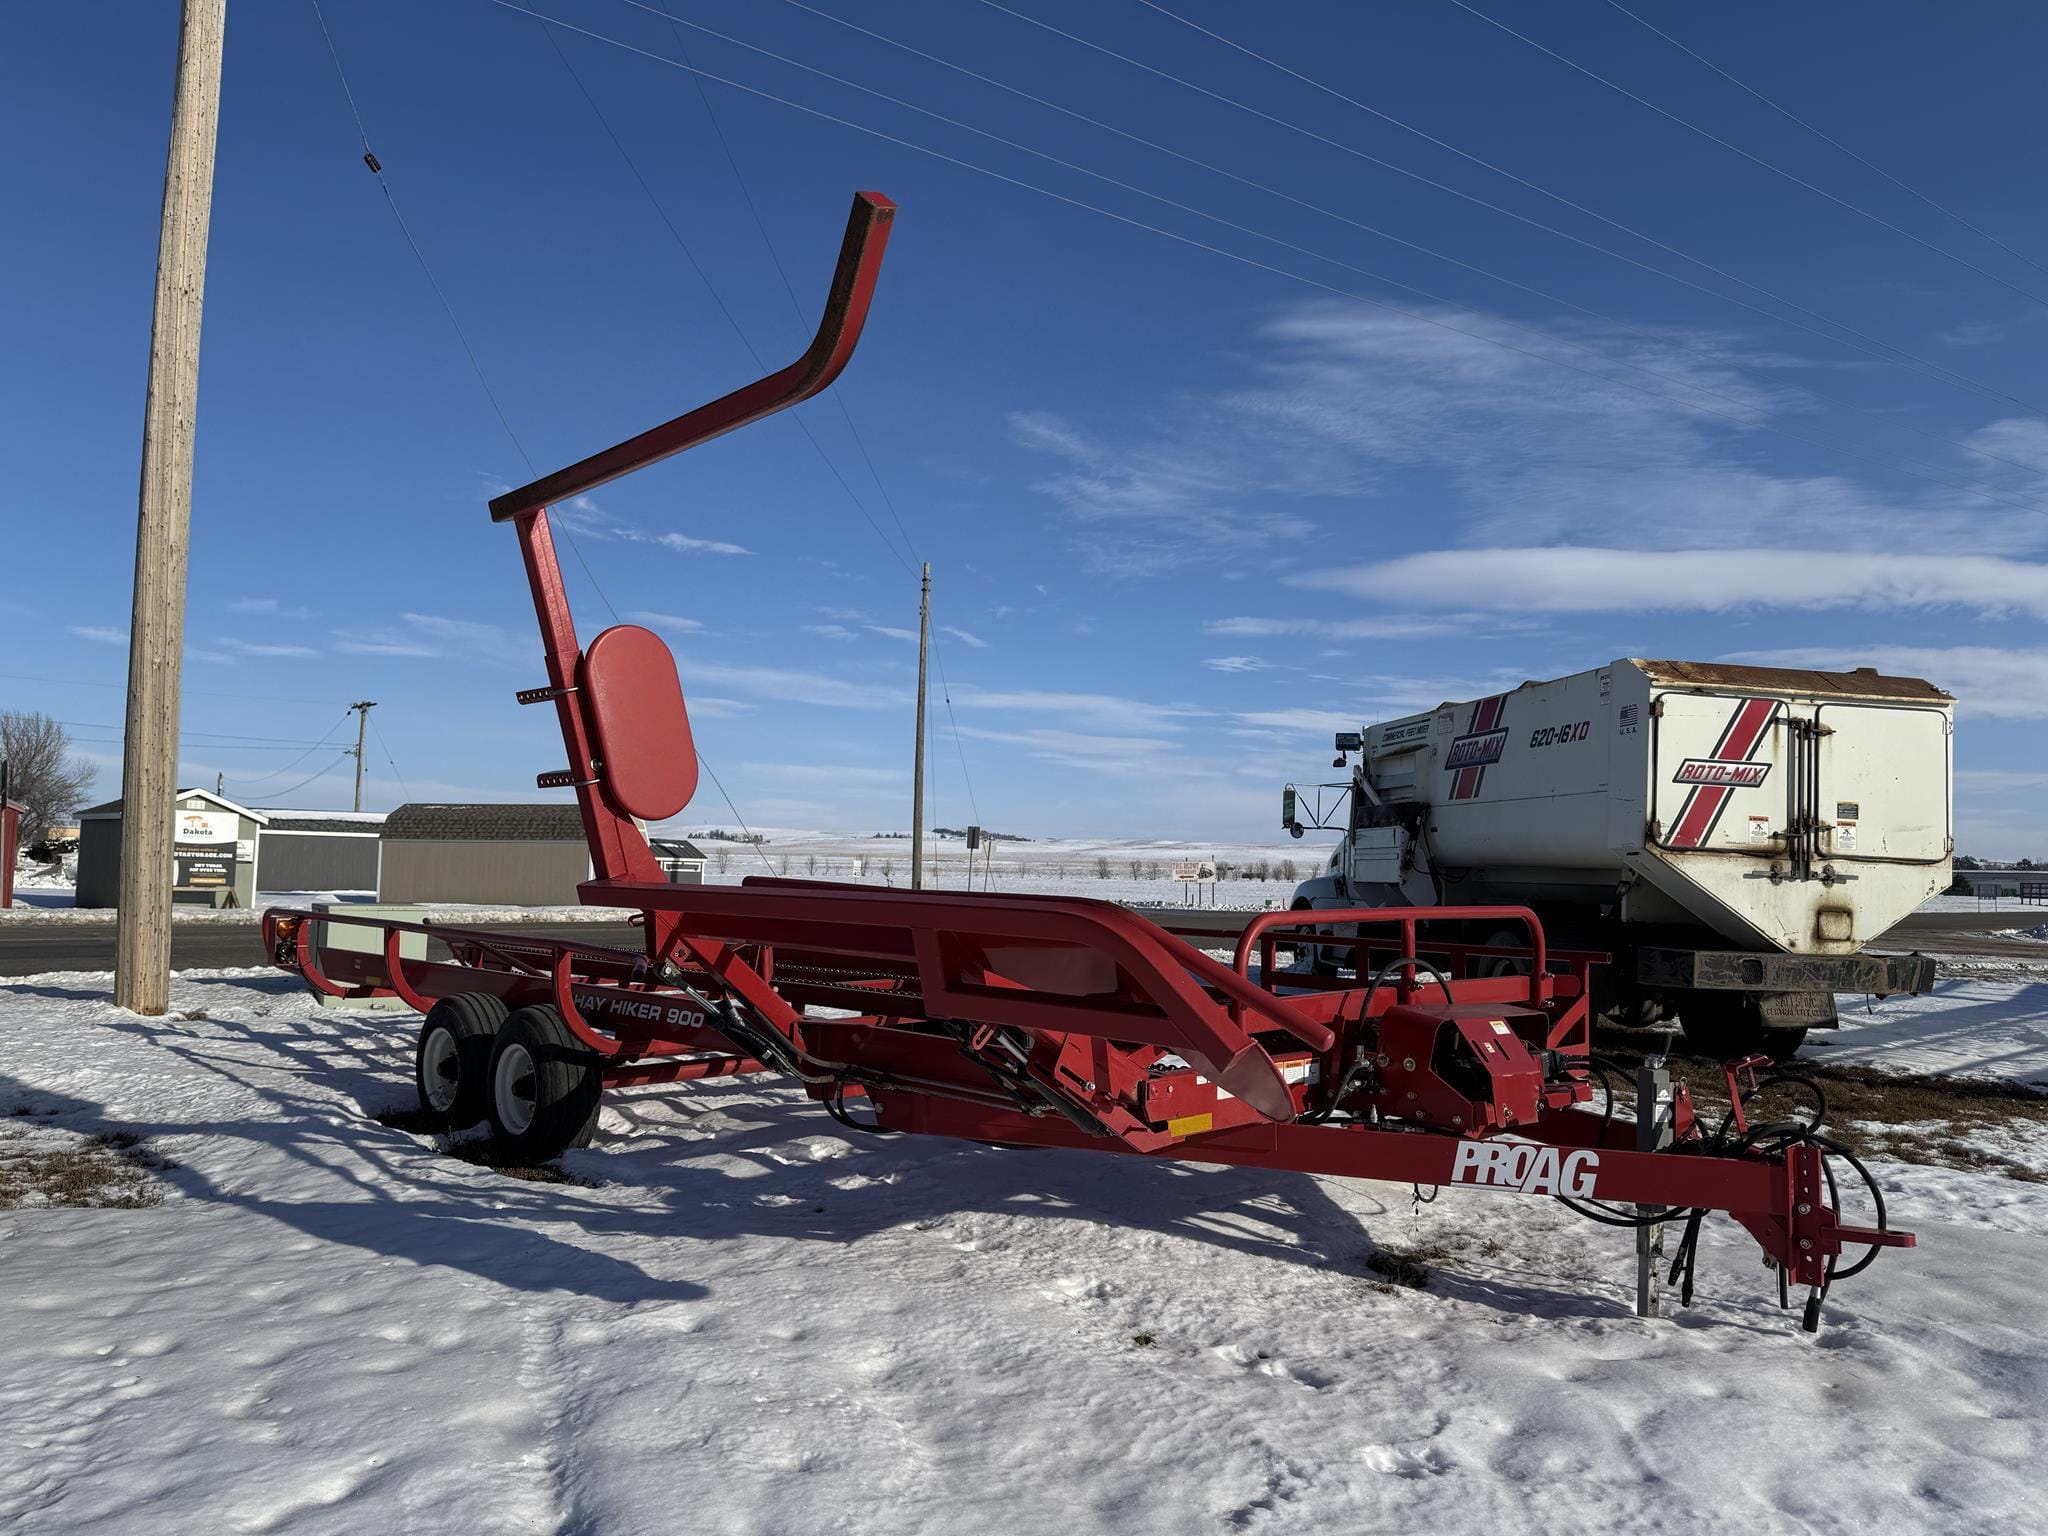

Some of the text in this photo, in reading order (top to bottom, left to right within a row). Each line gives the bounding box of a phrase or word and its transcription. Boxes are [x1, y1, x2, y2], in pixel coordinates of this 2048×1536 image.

[1450, 735, 1504, 764] ROTO-MIX
[1680, 763, 1765, 783] ROTO-MIX
[574, 993, 705, 1028] HAY HIKER 900
